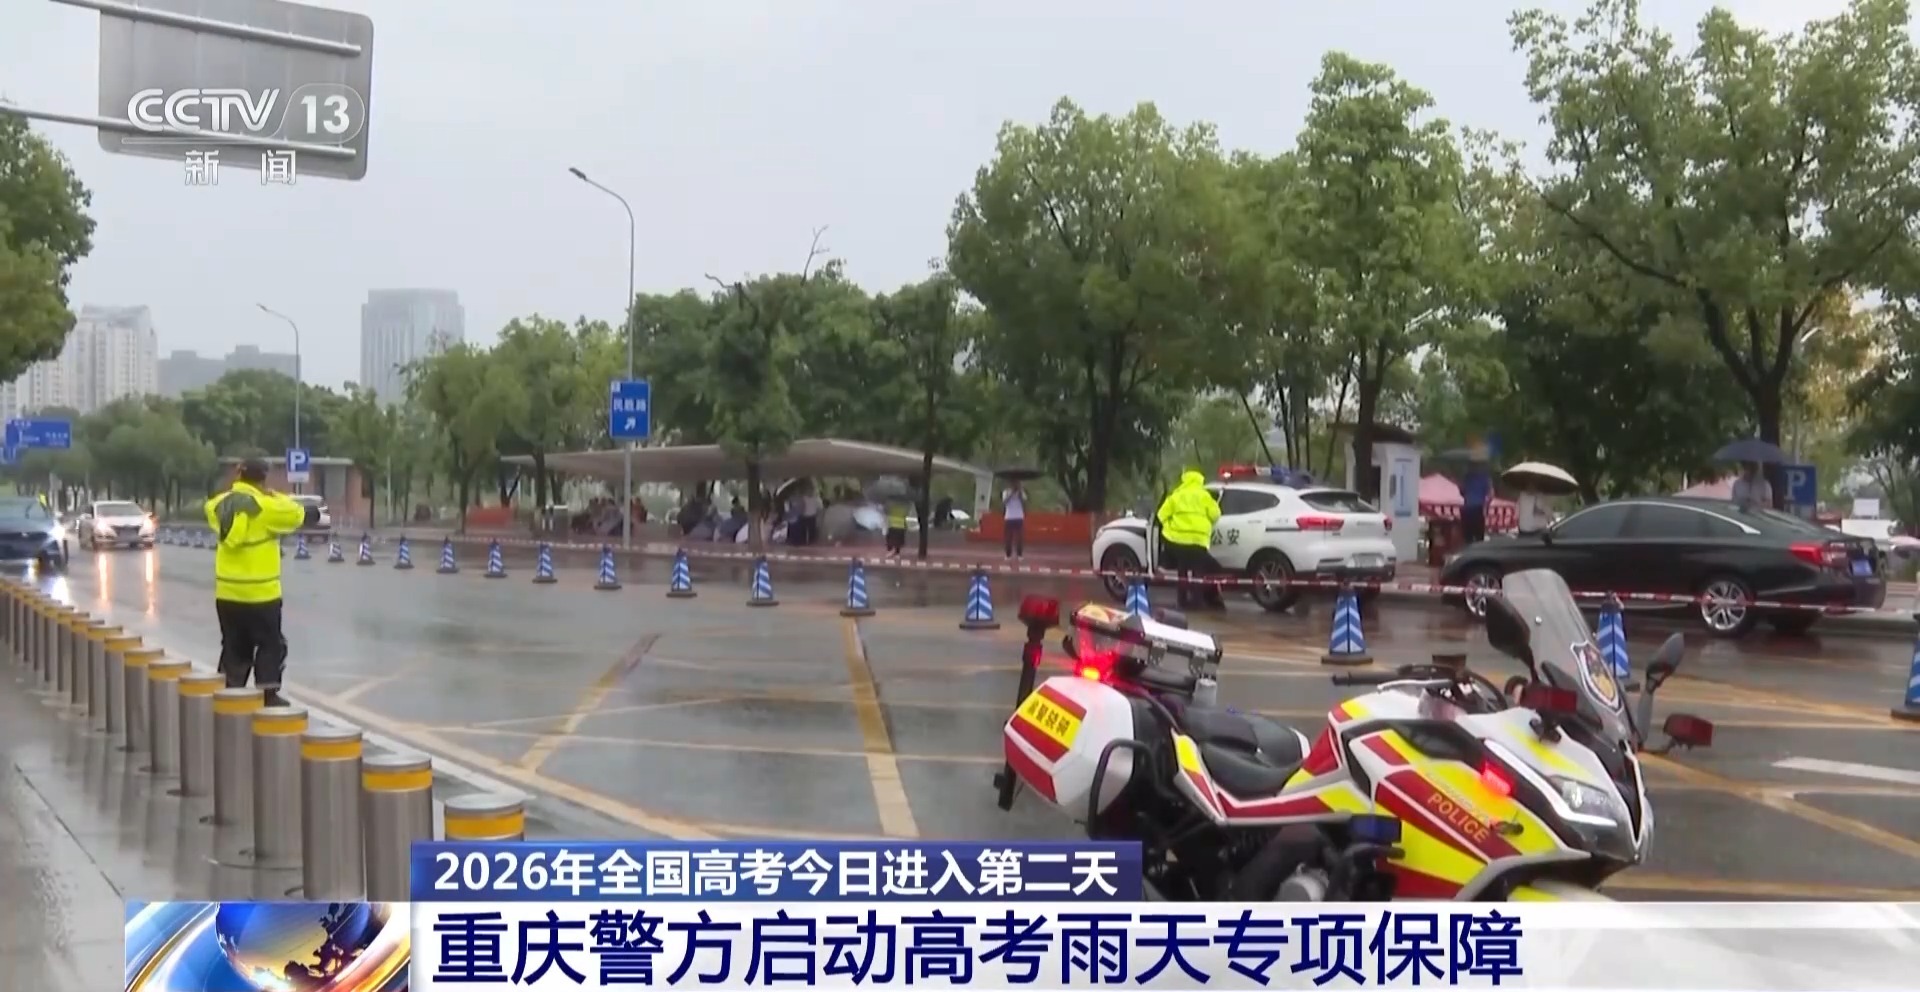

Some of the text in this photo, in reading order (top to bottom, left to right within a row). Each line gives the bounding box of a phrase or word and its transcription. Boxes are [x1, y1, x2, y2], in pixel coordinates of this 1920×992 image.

[290, 451, 306, 471] P
[1786, 469, 1806, 500] P
[1212, 528, 1240, 546] 公安
[1427, 793, 1489, 843] POLICE
